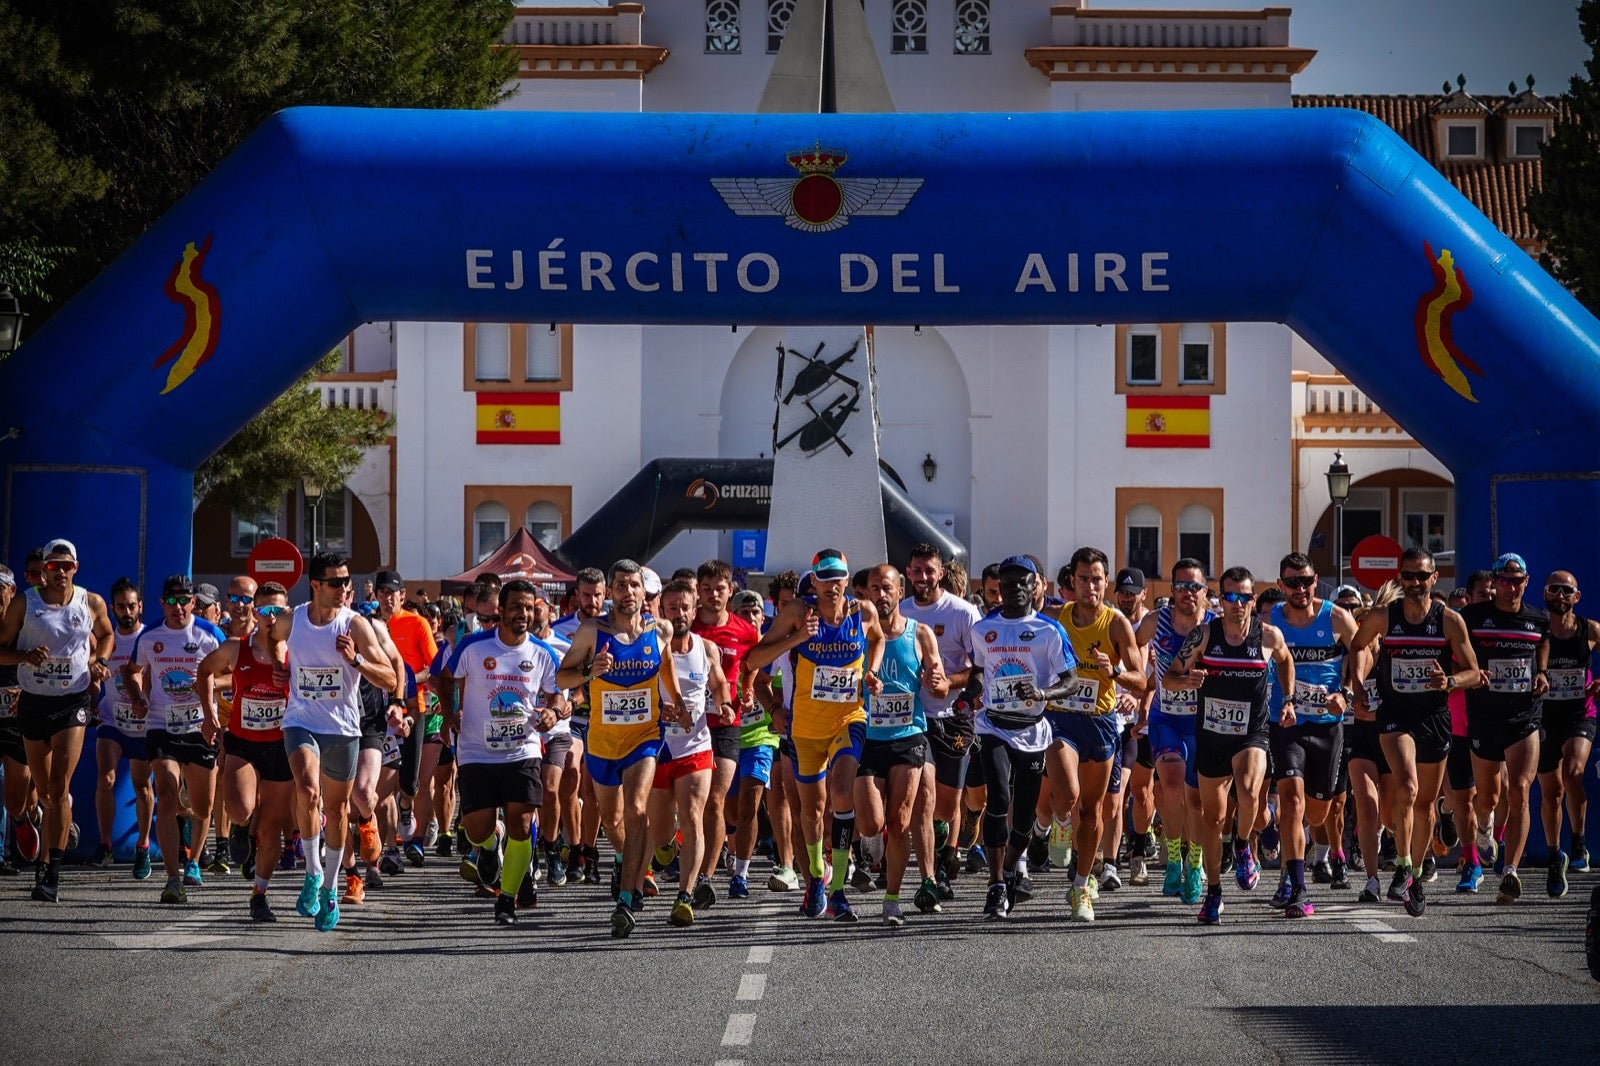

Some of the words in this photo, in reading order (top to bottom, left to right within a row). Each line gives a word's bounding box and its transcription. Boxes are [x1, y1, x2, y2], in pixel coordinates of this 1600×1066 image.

[465, 238, 780, 292] EJÉRCITO
[839, 253, 960, 293] DEL
[1014, 252, 1170, 292] AIRE
[808, 640, 861, 654] agustinos
[47, 664, 70, 674] 344
[1504, 667, 1527, 678] 307
[316, 674, 333, 686] 73
[830, 675, 853, 687] 291
[1172, 690, 1196, 701] 231
[1302, 691, 1327, 704] 248
[620, 697, 645, 710] 236
[886, 700, 910, 713] 304
[256, 706, 280, 718] 301
[1219, 708, 1244, 721] 310
[501, 724, 524, 737] 256
